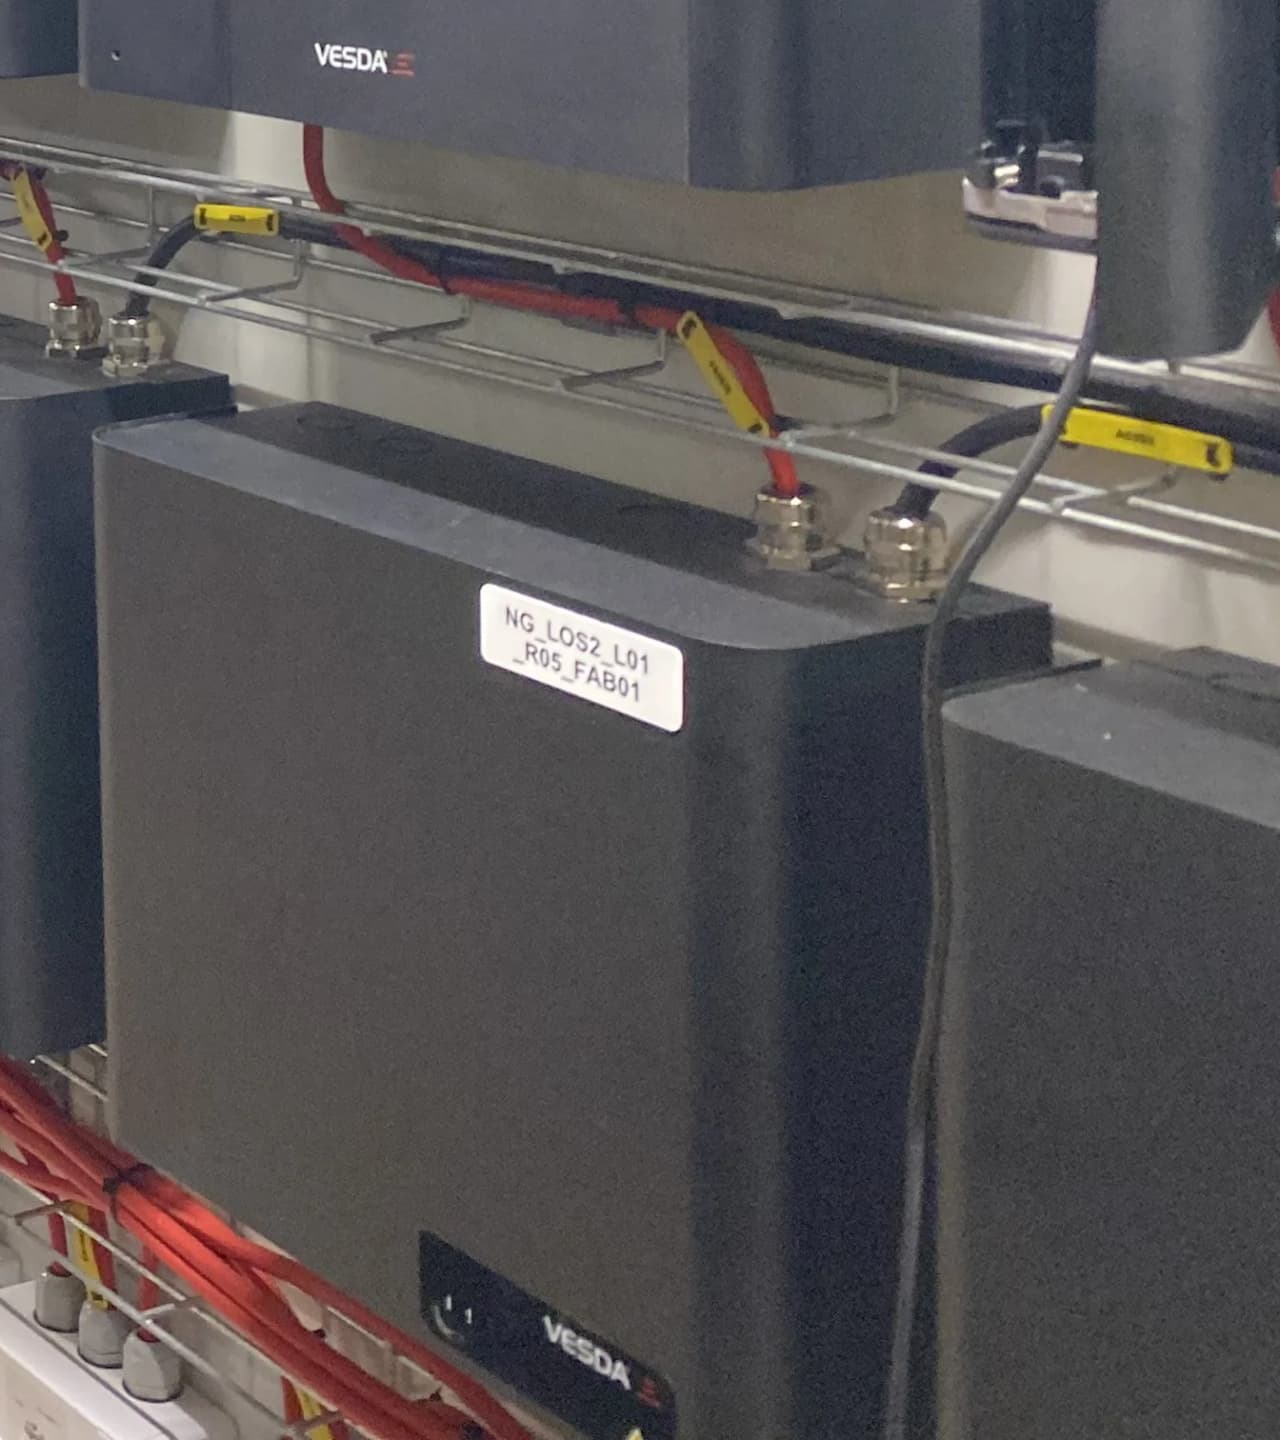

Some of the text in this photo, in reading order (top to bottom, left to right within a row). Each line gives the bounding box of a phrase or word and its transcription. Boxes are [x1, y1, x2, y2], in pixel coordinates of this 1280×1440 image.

[314, 42, 388, 74] VESDA
[505, 606, 649, 675] NG_LOS2_L01
[512, 641, 640, 703] _R05_FAB01
[543, 1314, 632, 1391] VESDA
